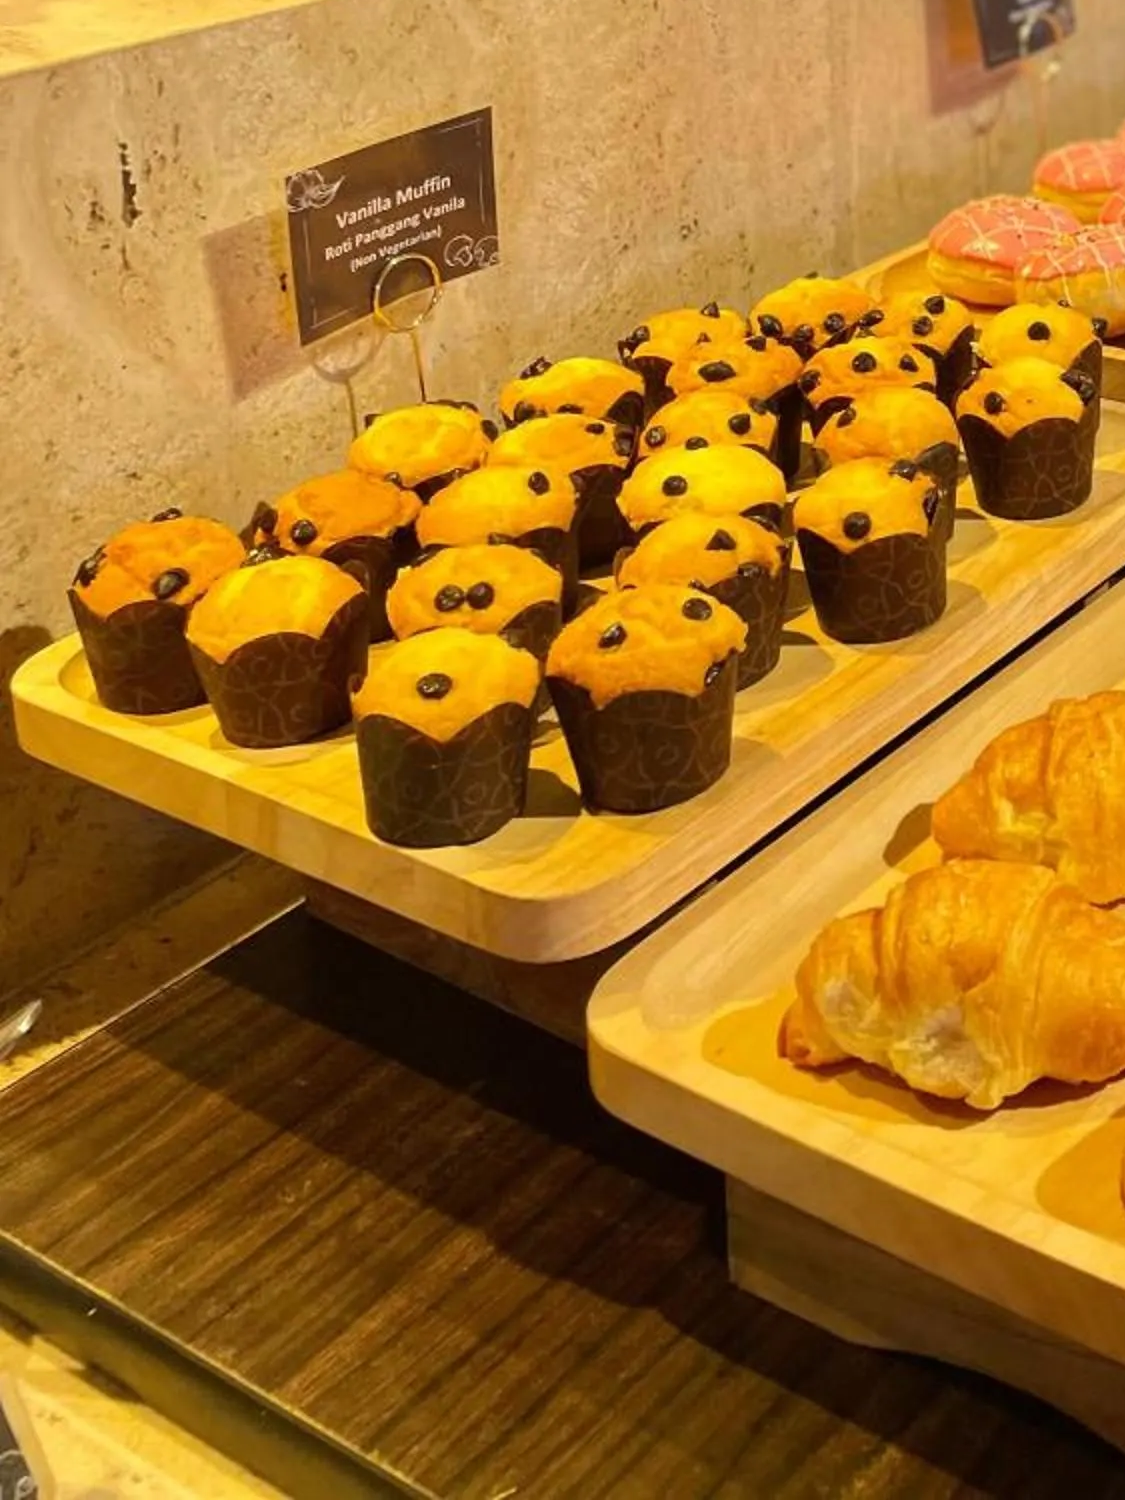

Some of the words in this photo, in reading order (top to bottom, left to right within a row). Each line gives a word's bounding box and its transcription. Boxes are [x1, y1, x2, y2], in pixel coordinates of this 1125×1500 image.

[324, 237, 353, 261] Roti
[355, 213, 421, 247] Panggang
[422, 196, 466, 220] Vanila
[336, 196, 391, 229] Vanilla
[395, 175, 451, 206] Muffin
